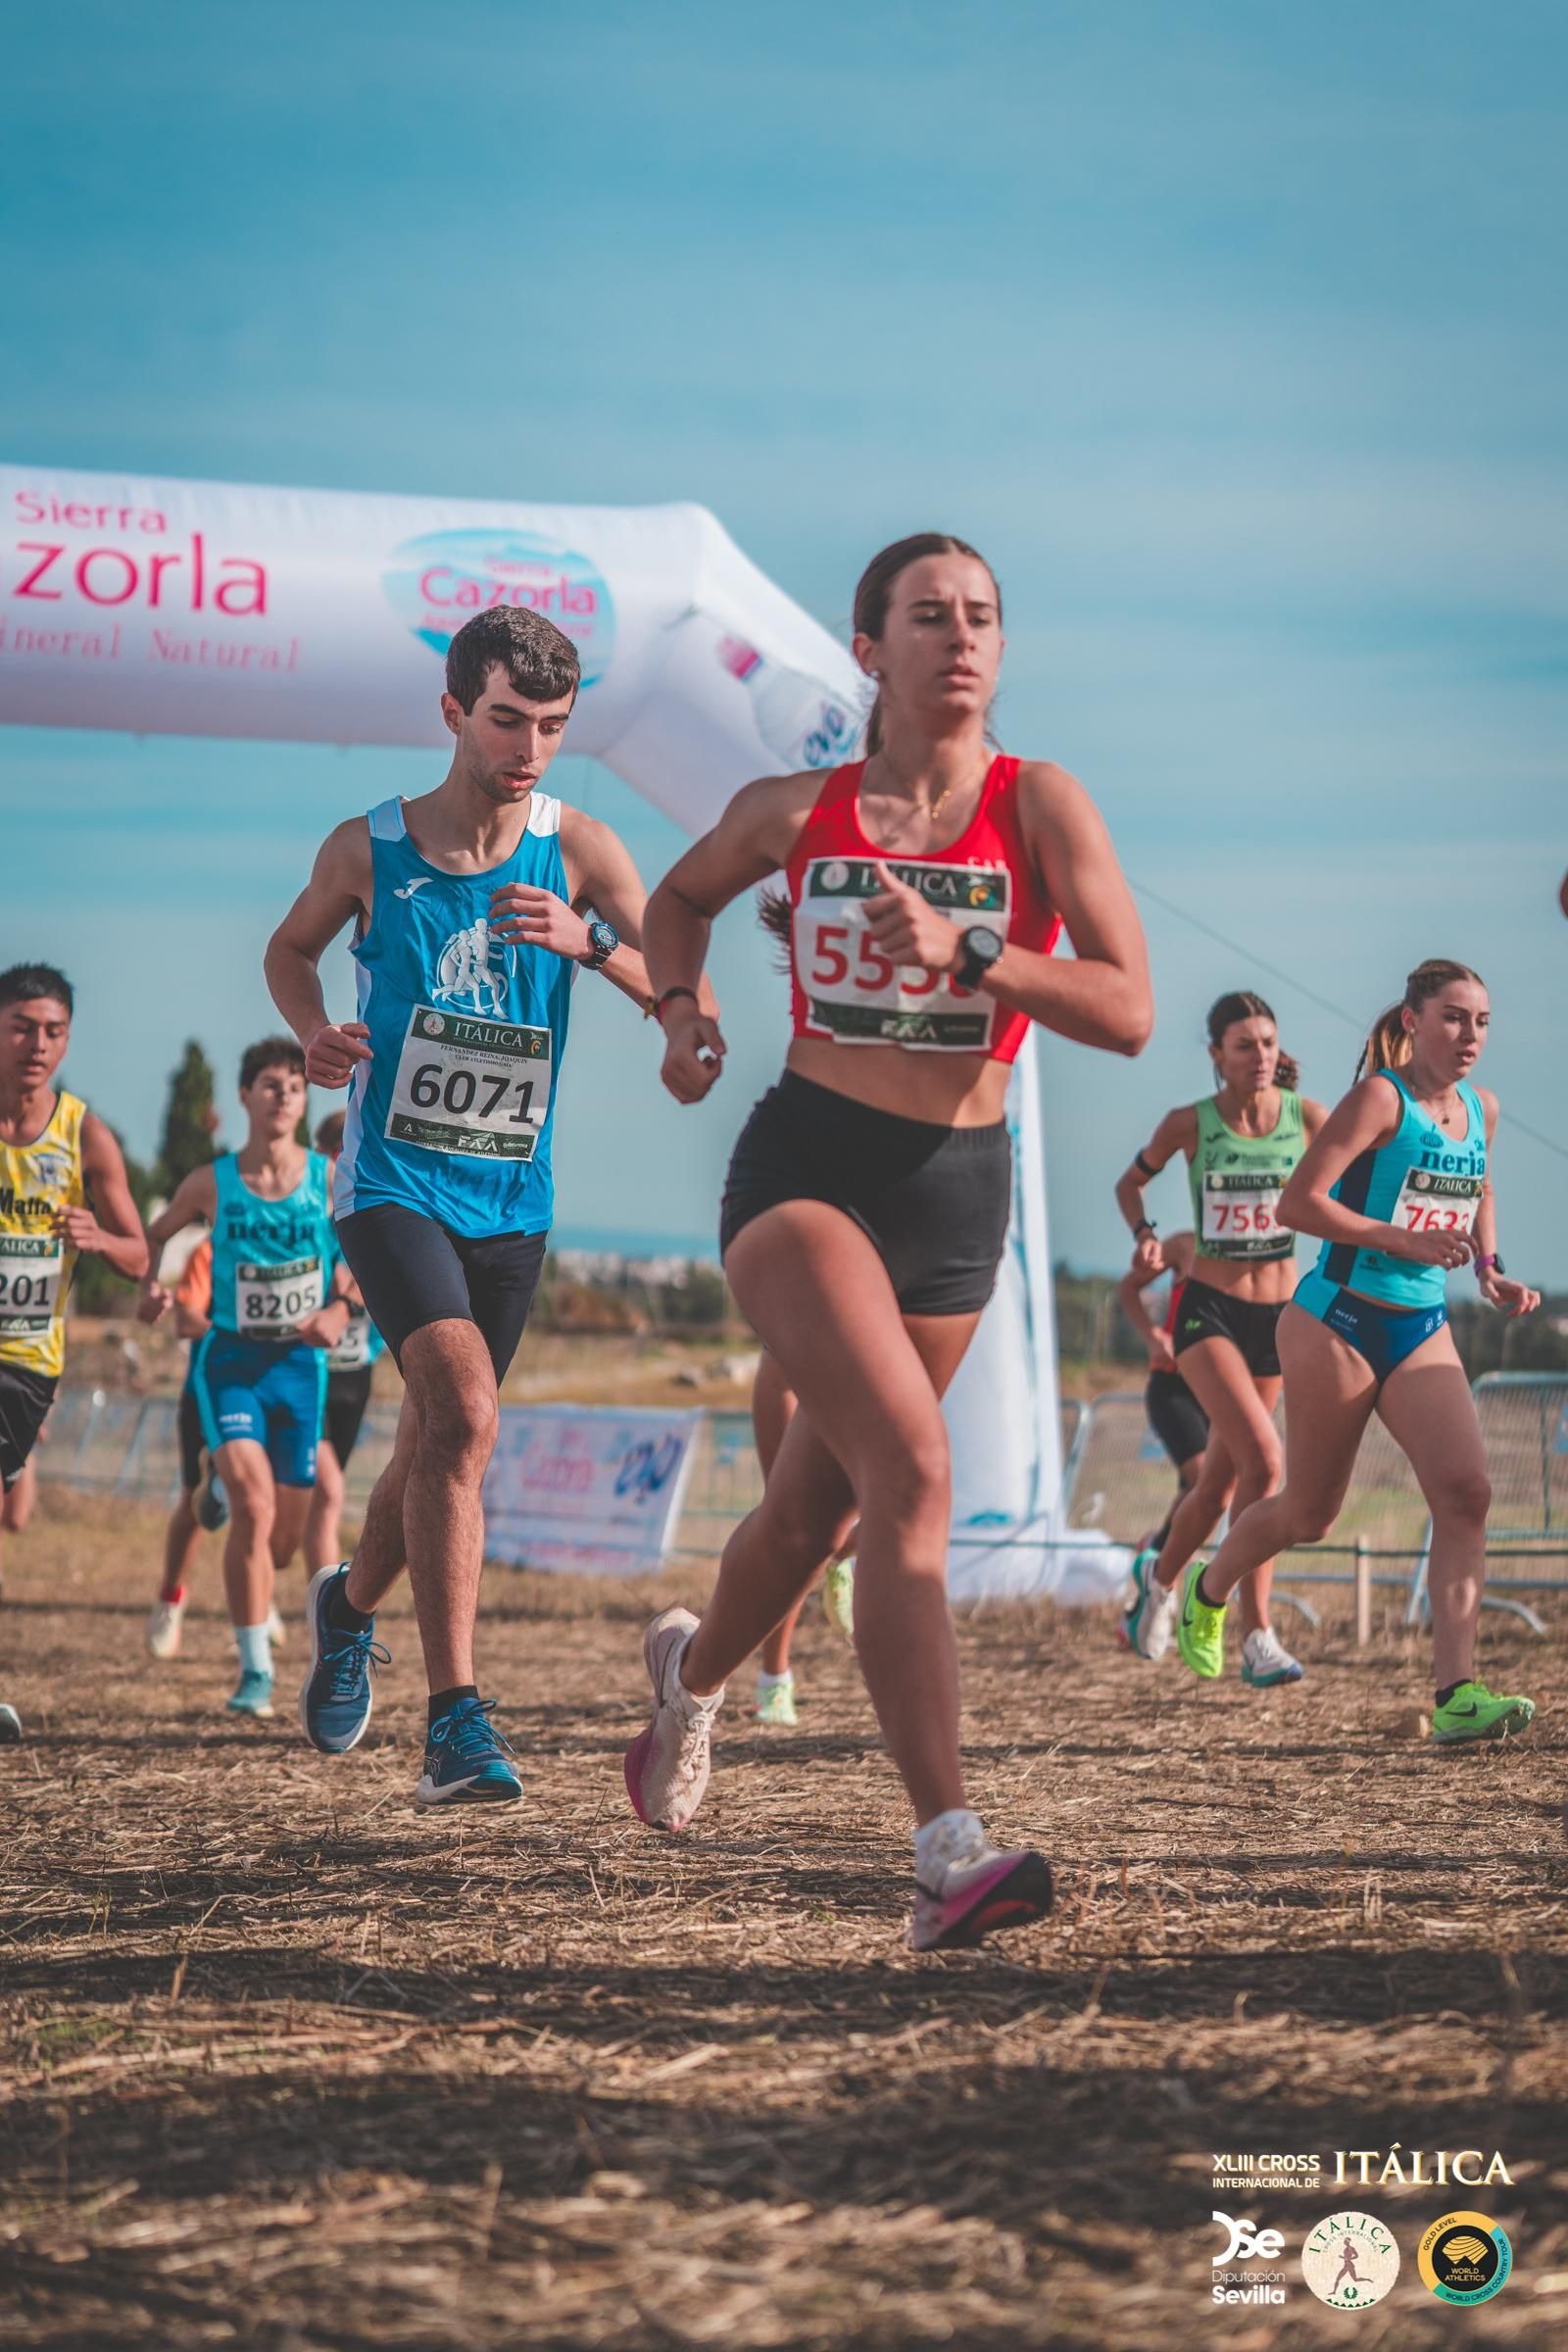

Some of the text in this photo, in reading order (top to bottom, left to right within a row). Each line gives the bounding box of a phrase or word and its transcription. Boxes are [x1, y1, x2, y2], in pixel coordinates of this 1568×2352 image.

[15, 491, 167, 534] Sierra
[13, 533, 266, 616] zorla
[419, 567, 596, 613] Cazorla
[455, 1022, 522, 1048] ITÁLICA
[411, 1064, 534, 1123] 6071
[1419, 1151, 1485, 1176] nerja
[1213, 1204, 1281, 1231] 756
[246, 1286, 316, 1319] 8205
